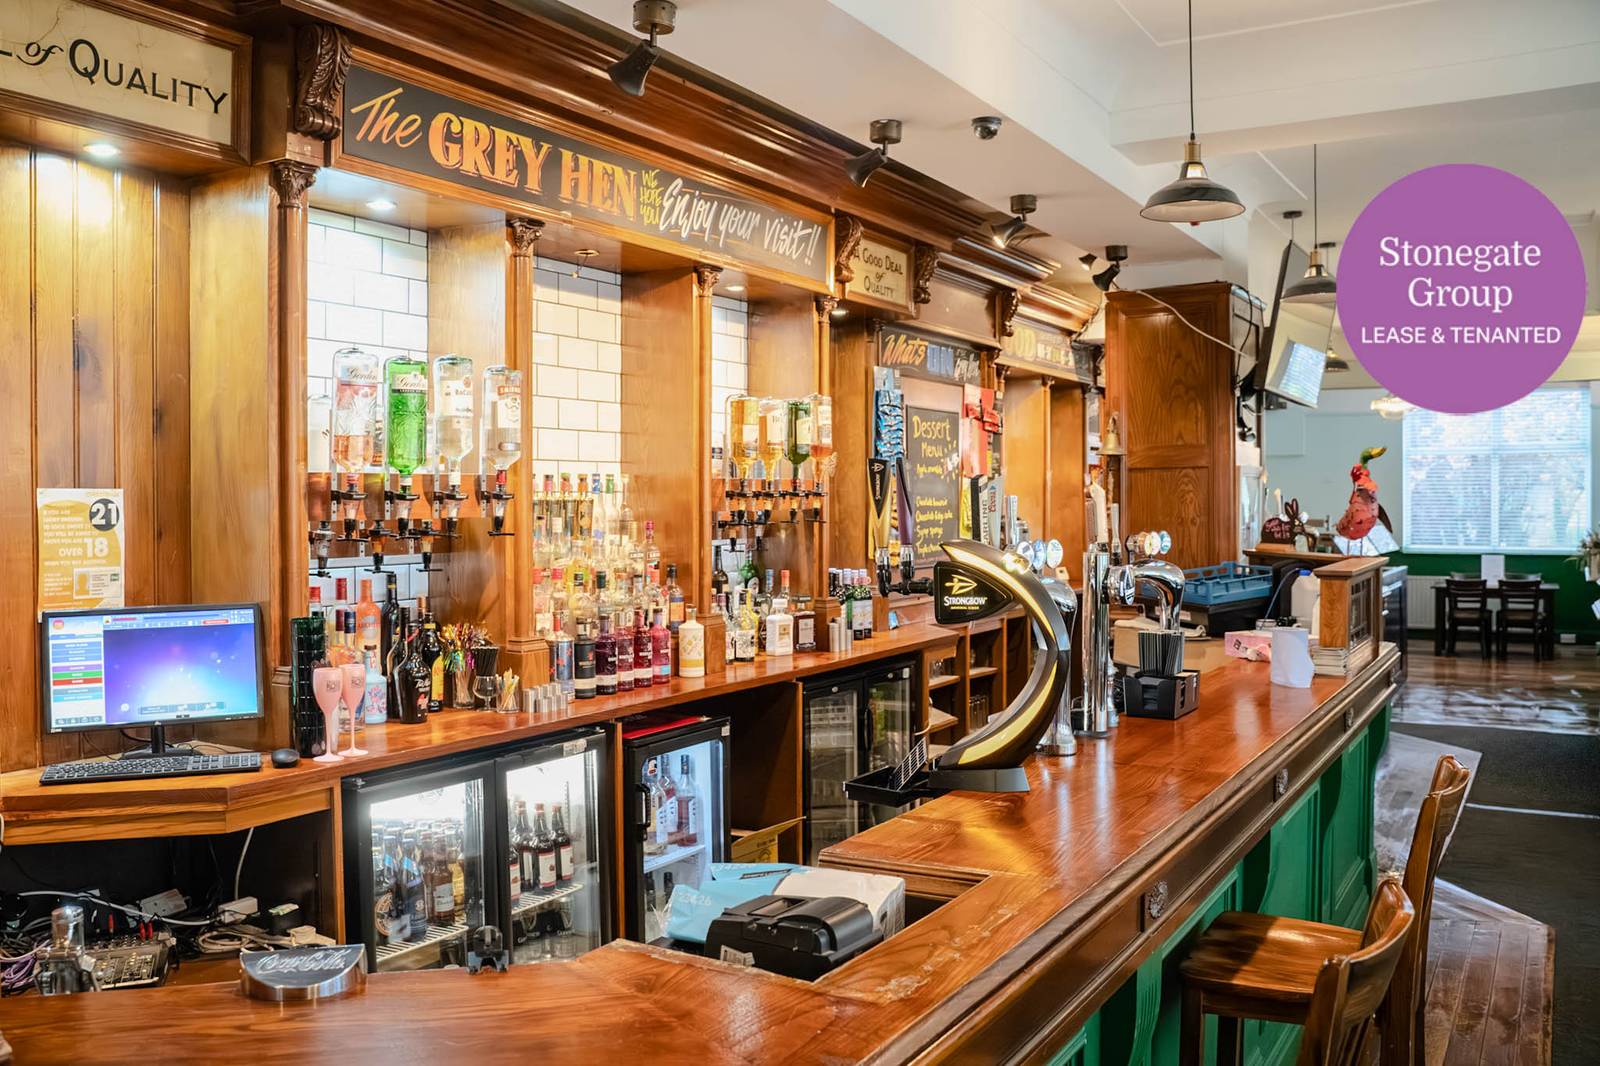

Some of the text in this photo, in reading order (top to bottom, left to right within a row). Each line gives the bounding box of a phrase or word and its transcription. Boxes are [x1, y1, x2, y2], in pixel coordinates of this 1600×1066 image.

[16, 38, 228, 114] of QUALITY
[350, 87, 637, 222] The GREY HEN
[642, 169, 660, 188] WE
[640, 186, 664, 206] HOPE
[659, 177, 718, 241] Enjoy
[718, 202, 761, 248] your
[862, 247, 883, 268] GOOD
[885, 255, 903, 275] DEAL
[912, 415, 951, 442] Dessert
[921, 441, 944, 459] Menu
[91, 502, 118, 526] 21
[58, 537, 109, 558] OVER 18
[943, 595, 988, 607] STRONGBOW
